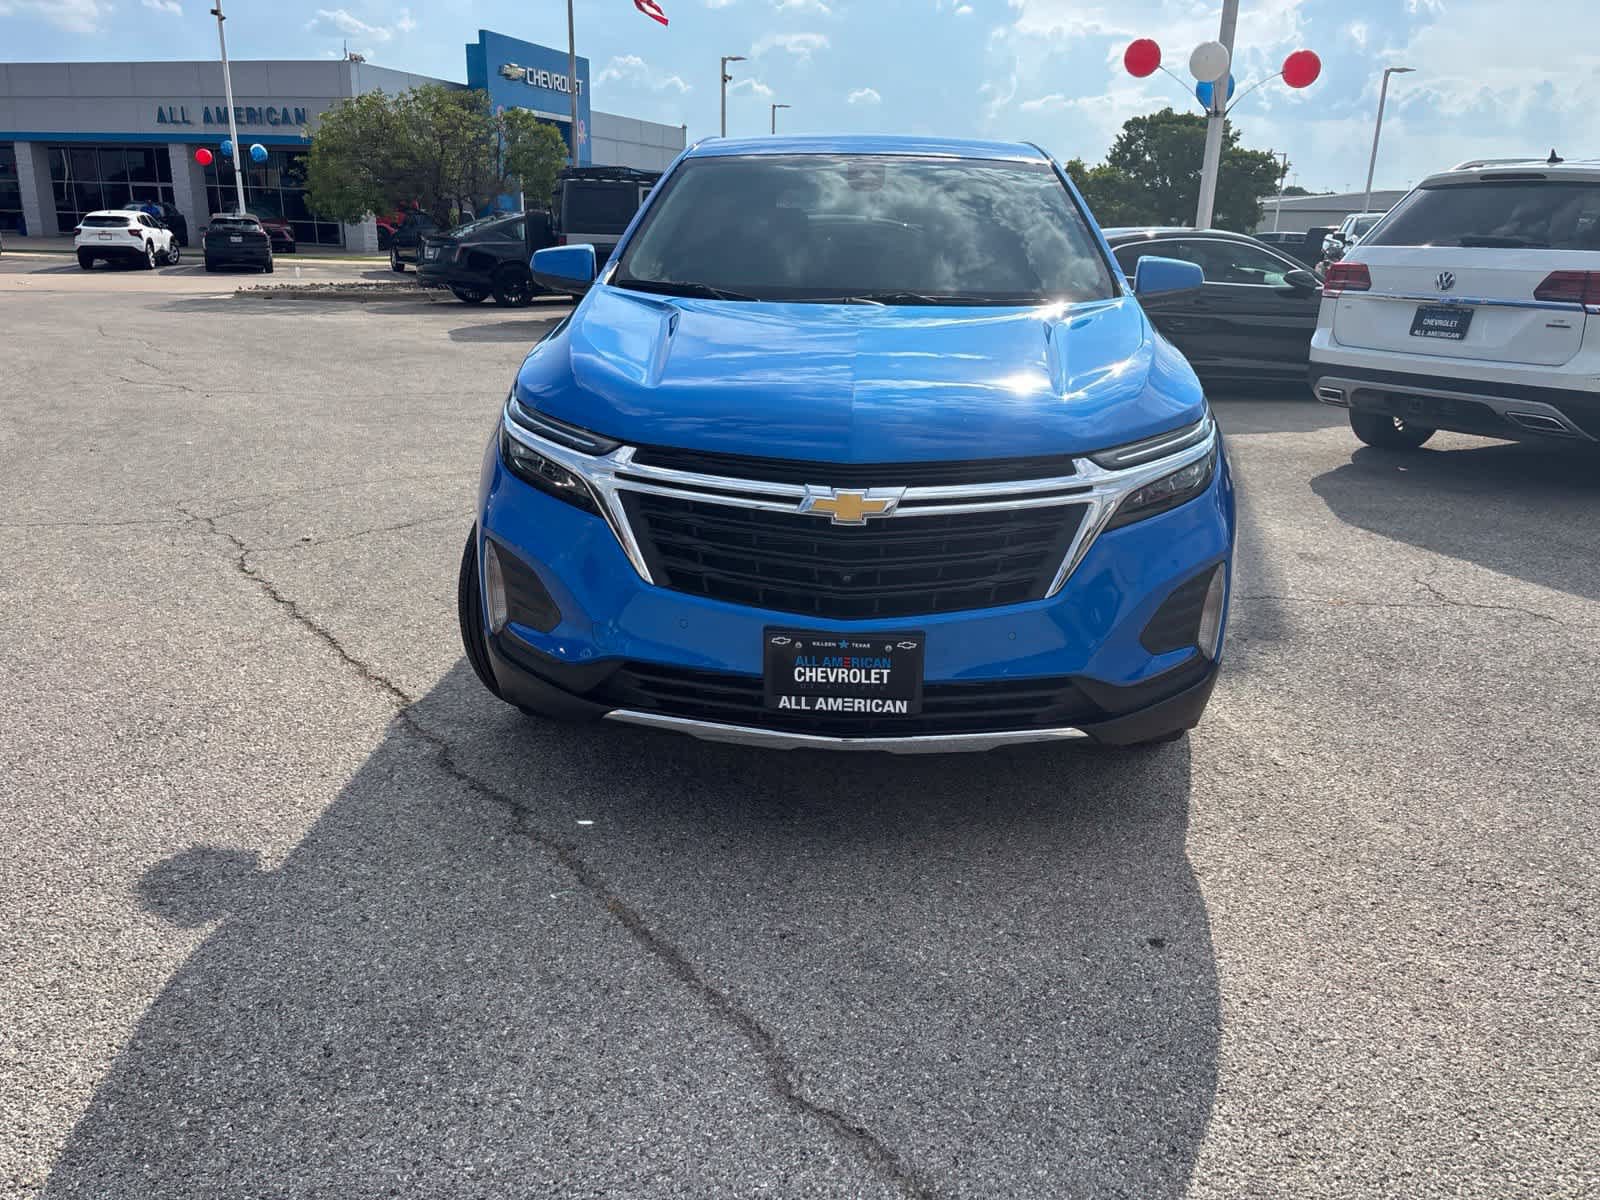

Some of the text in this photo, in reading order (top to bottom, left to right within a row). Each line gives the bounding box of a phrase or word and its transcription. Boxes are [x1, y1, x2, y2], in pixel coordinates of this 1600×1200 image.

[156, 106, 307, 125] ALL AMERICAN
[1423, 319, 1458, 328] CHEVROLET
[794, 655, 891, 668] ALL AMERICAN
[793, 667, 892, 684] CHEVROLET
[778, 695, 908, 713] ALL AMERICAN
